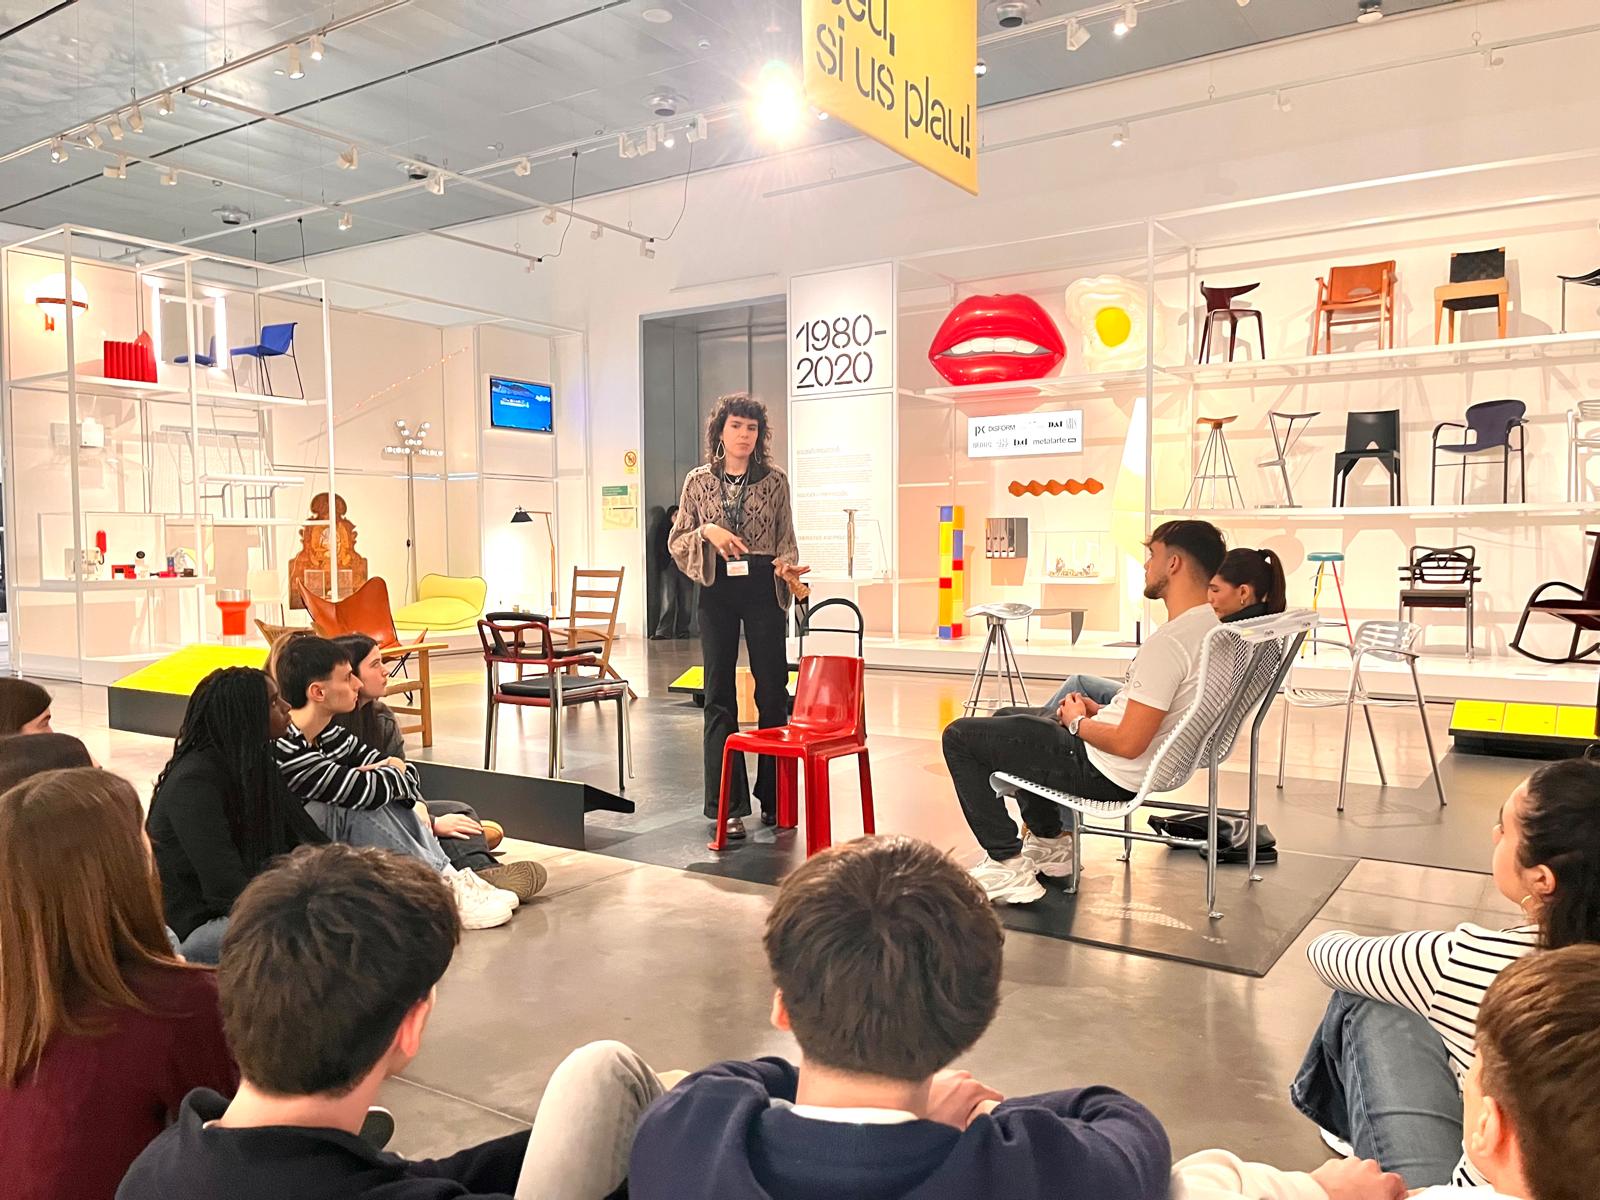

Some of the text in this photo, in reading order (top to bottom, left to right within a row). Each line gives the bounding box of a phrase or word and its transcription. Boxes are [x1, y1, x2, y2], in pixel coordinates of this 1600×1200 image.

[816, 15, 971, 160] si us plau!
[796, 314, 887, 352] 1980-
[796, 351, 873, 389] 2020
